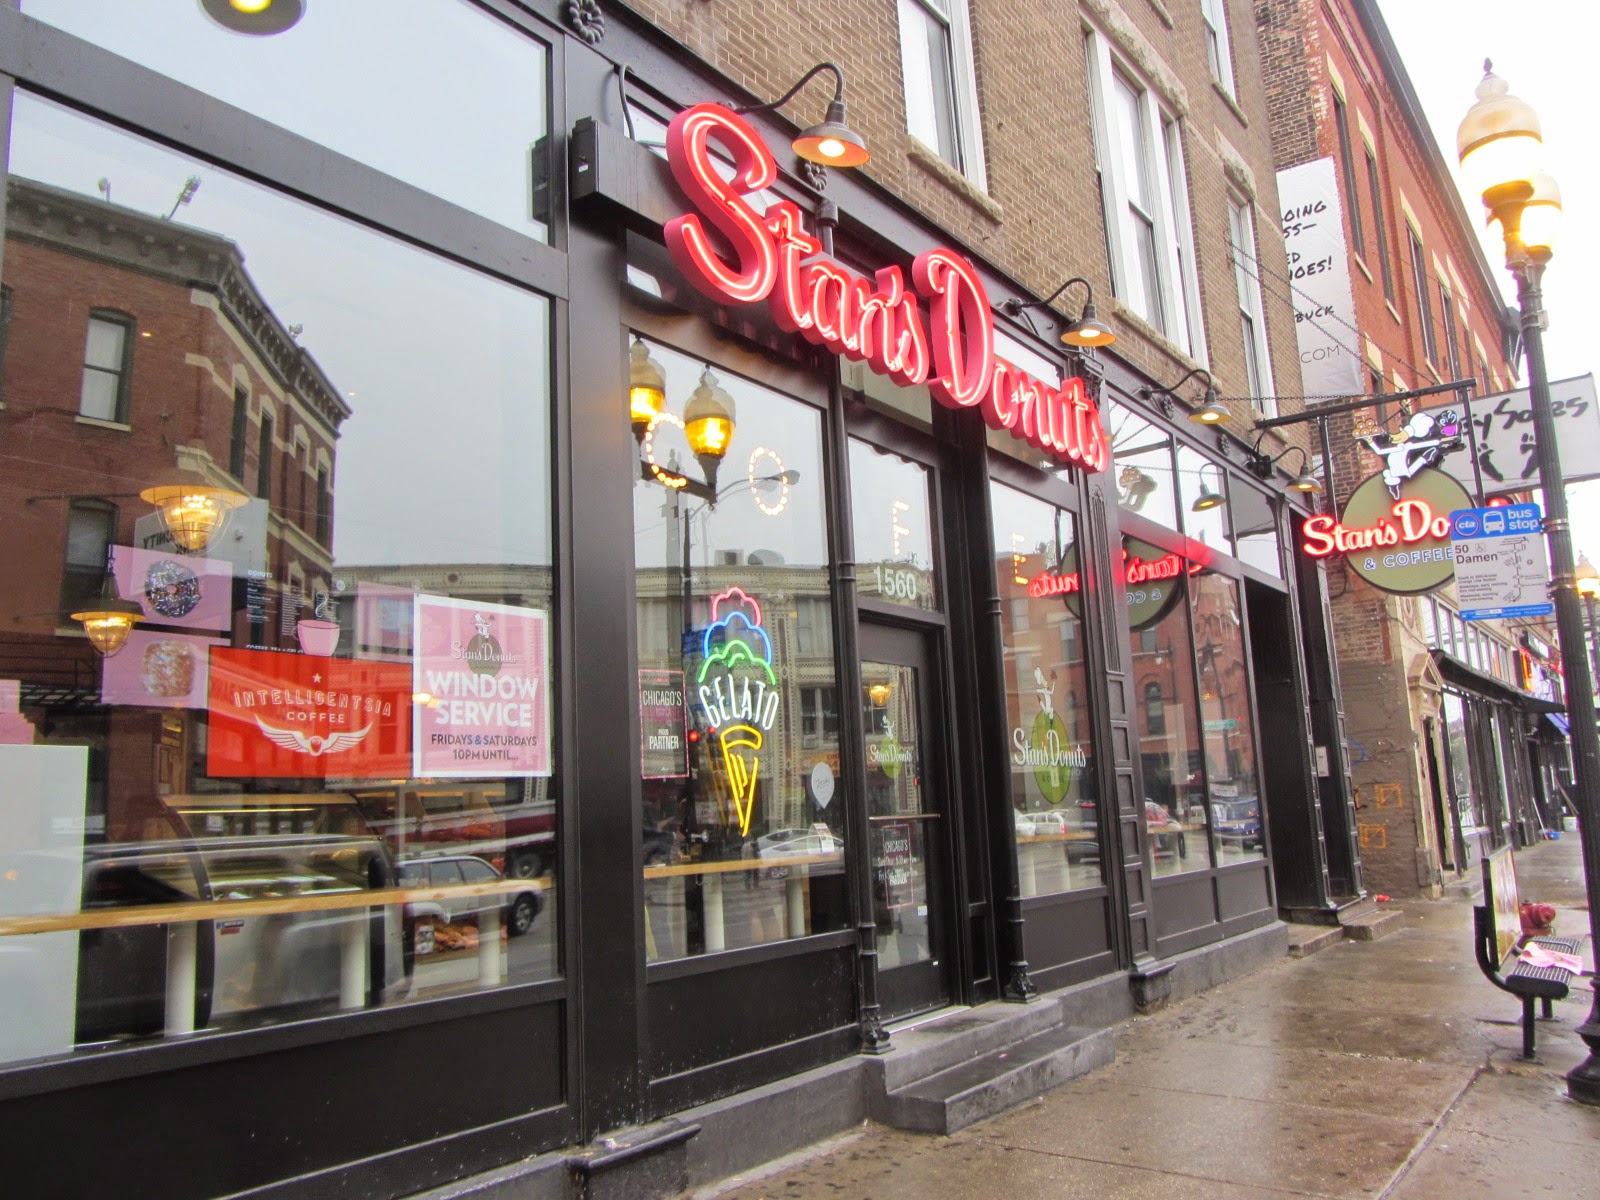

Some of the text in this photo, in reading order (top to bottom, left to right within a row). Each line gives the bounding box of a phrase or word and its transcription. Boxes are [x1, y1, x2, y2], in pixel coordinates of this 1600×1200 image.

[1283, 201, 1327, 222] OING
[664, 102, 1109, 473] Stan's Donuts
[1295, 306, 1334, 323] BUCK
[1493, 397, 1589, 430] Soes
[1507, 509, 1532, 519] bus
[1458, 520, 1476, 529] cta
[1508, 519, 1539, 531] stop
[1302, 514, 1398, 557] Stan's
[1364, 547, 1453, 570] & COFFEE
[1455, 544, 1469, 554] 50
[1456, 553, 1498, 565] Damen
[874, 565, 917, 601] 1560
[452, 641, 482, 660] Stan's
[427, 670, 539, 700] WINDOW
[233, 689, 392, 717] INTELLIGENTSIA
[642, 690, 682, 706] CHICAGO'S
[698, 674, 780, 731] GELATO
[286, 711, 345, 724] COFFEE
[435, 700, 532, 728] SERVICE
[431, 734, 538, 746] FRIDAYS & SATURDAYS
[649, 735, 679, 750] PARTNER
[1013, 728, 1087, 767] Stan's Donuts
[453, 750, 480, 760] 10PM
